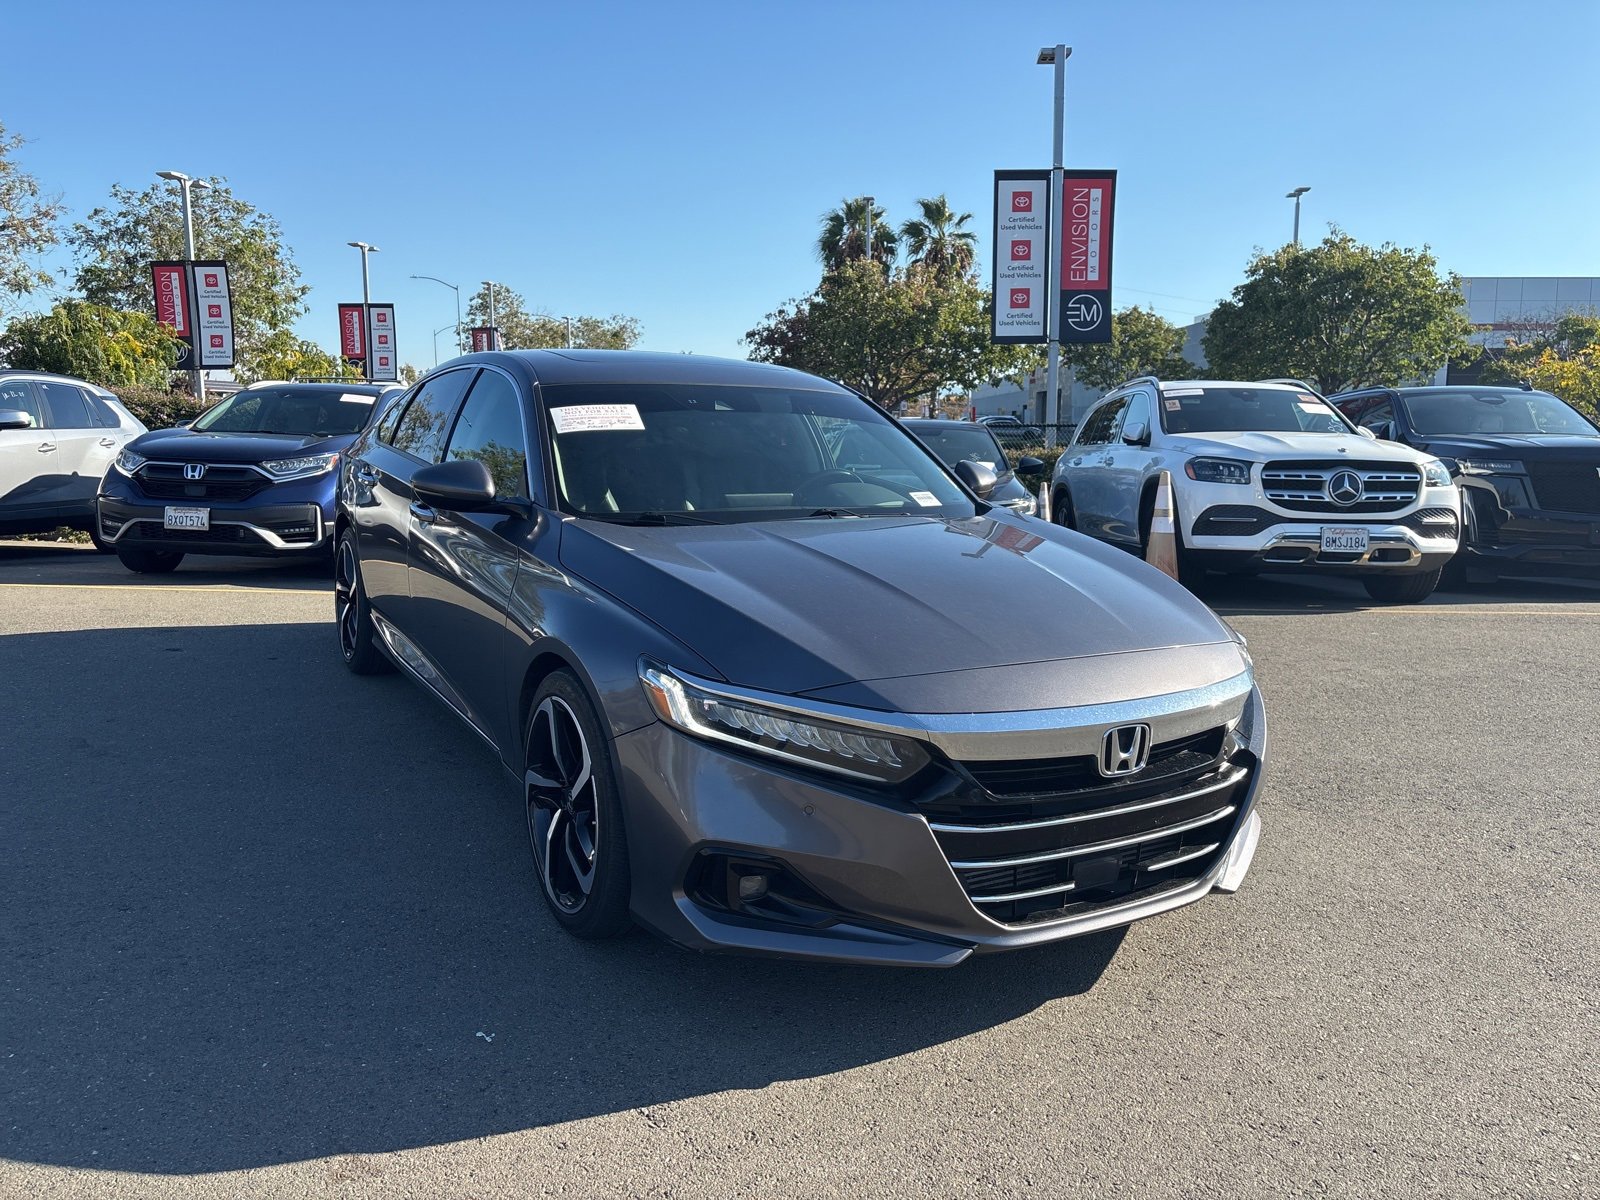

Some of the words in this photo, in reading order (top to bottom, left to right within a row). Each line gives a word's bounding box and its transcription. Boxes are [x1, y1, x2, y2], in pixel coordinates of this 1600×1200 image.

[1071, 188, 1089, 281] ENVISION
[1090, 196, 1100, 274] MOTORS
[160, 272, 175, 326] NVISION
[345, 311, 355, 354] ENVISION
[1325, 536, 1366, 548] 8MSJ184
